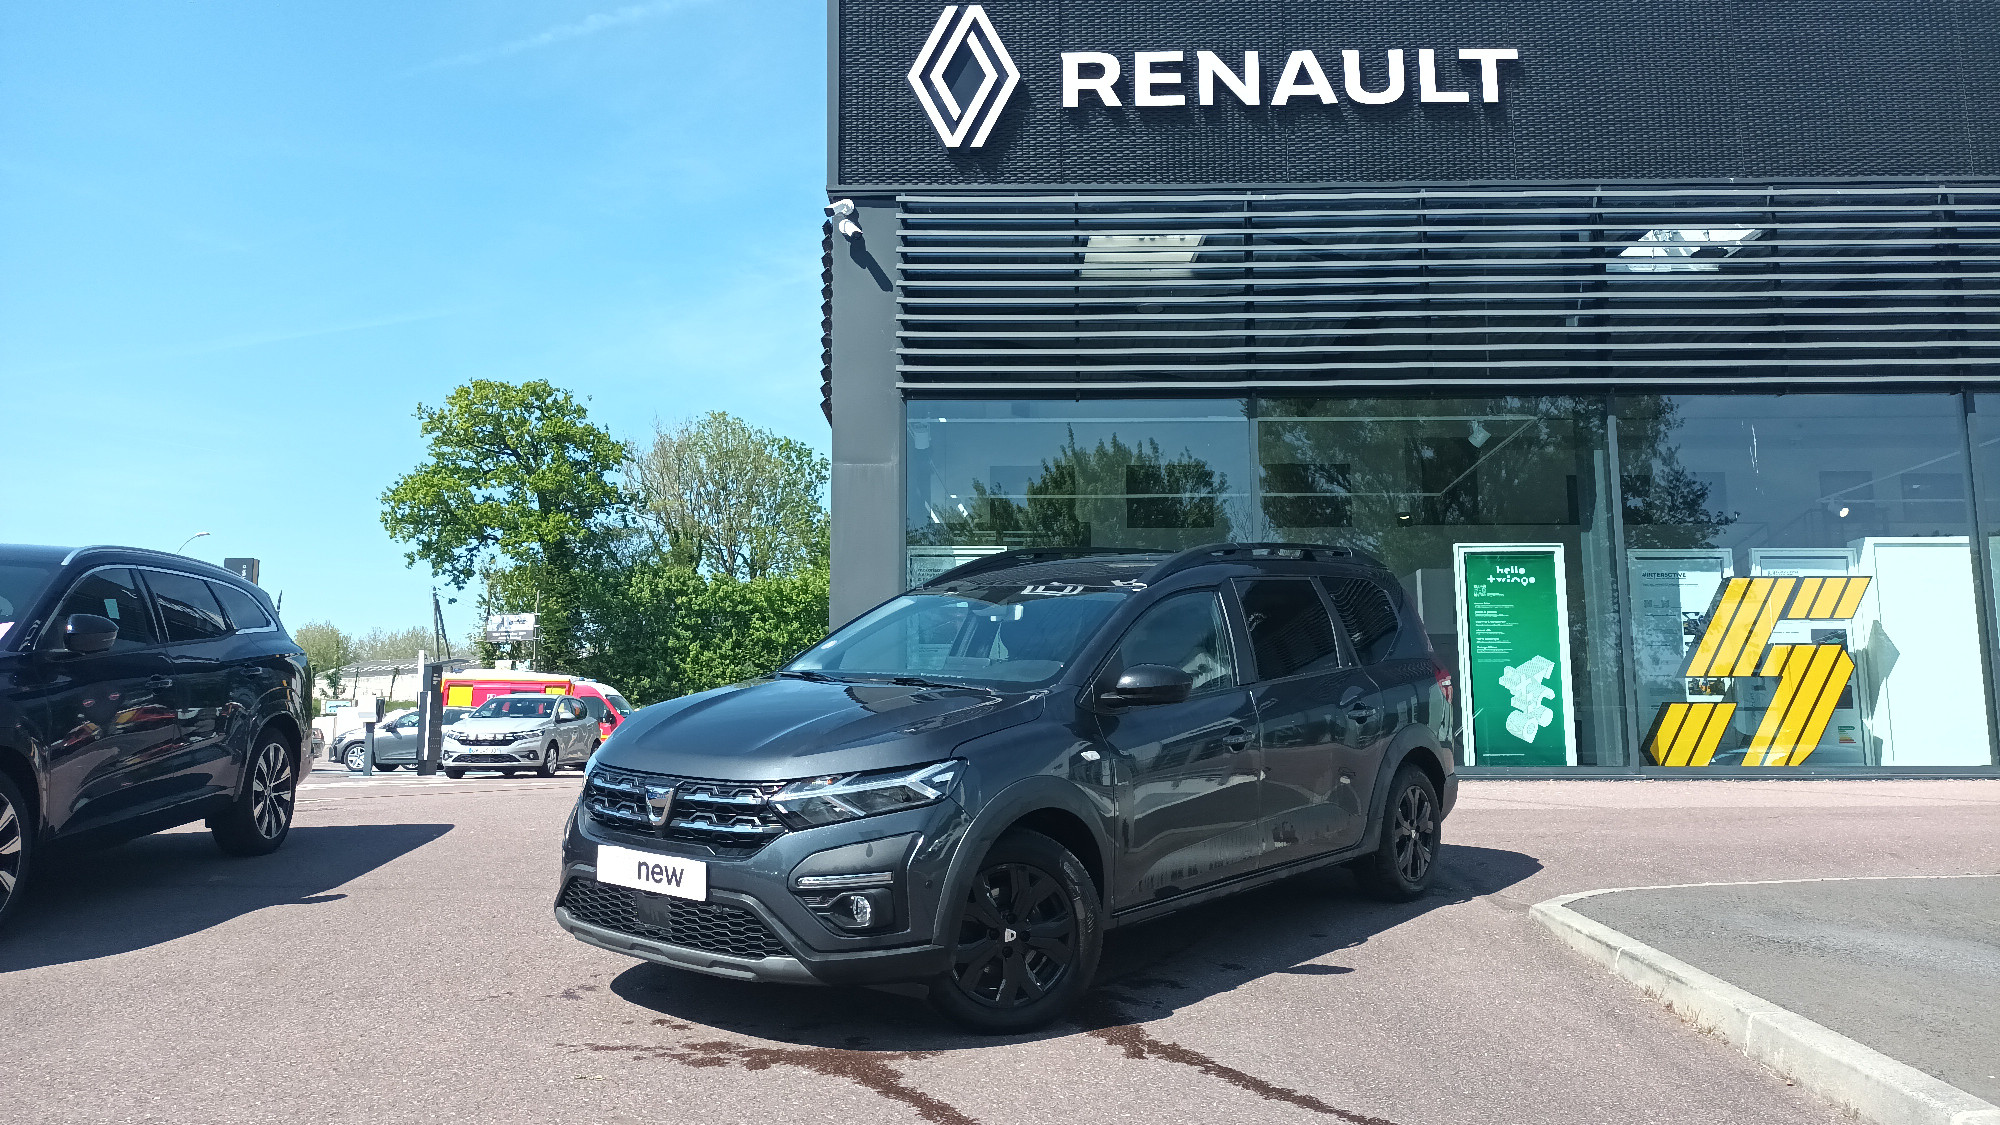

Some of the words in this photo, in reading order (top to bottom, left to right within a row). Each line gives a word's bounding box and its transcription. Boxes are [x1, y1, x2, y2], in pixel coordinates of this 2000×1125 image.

[1061, 48, 1519, 108] RENAULT
[1496, 565, 1526, 575] hello
[637, 861, 685, 888] new
